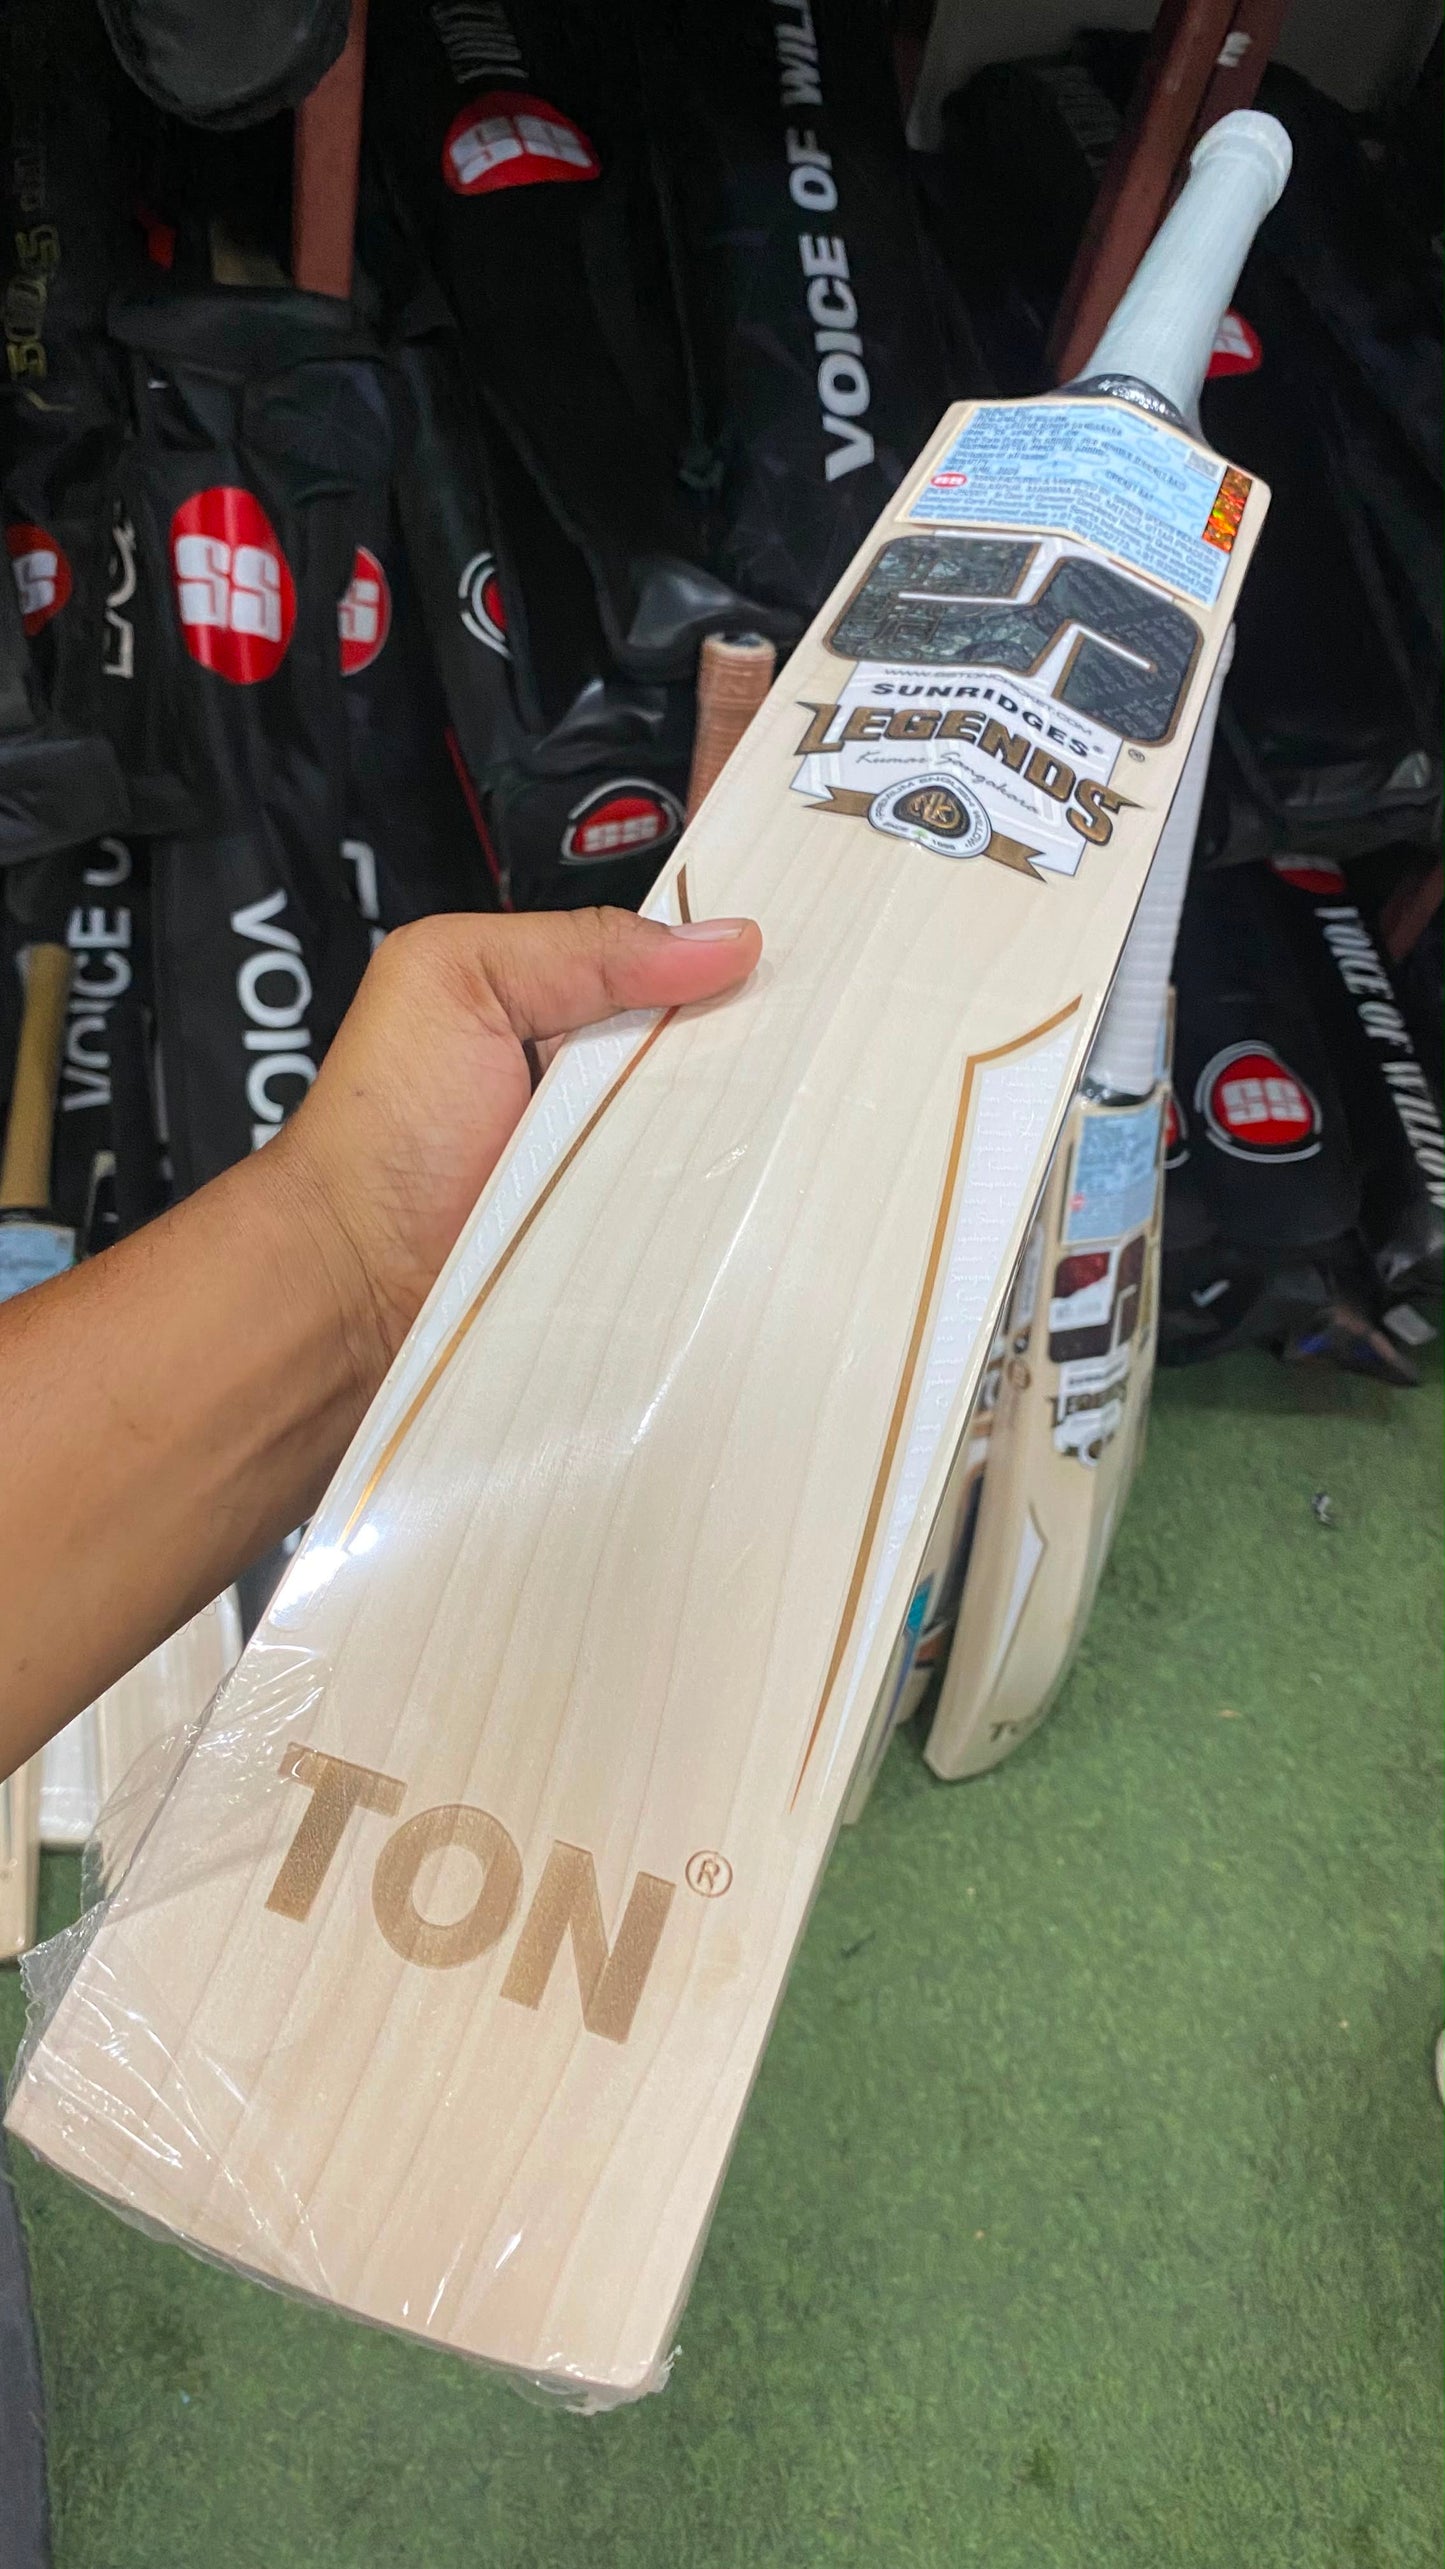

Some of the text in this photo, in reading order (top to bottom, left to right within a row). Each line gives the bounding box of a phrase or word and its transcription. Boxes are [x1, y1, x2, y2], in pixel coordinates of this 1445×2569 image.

[449, 113, 594, 185] SS
[785, 126, 839, 212] OF
[799, 232, 876, 482] VOICE
[173, 533, 282, 643] SS
[872, 682, 1090, 758] SUNRIDGES
[794, 701, 1145, 847] LEGENDS
[1220, 1077, 1309, 1126] SS
[263, 1742, 677, 2045] TON
